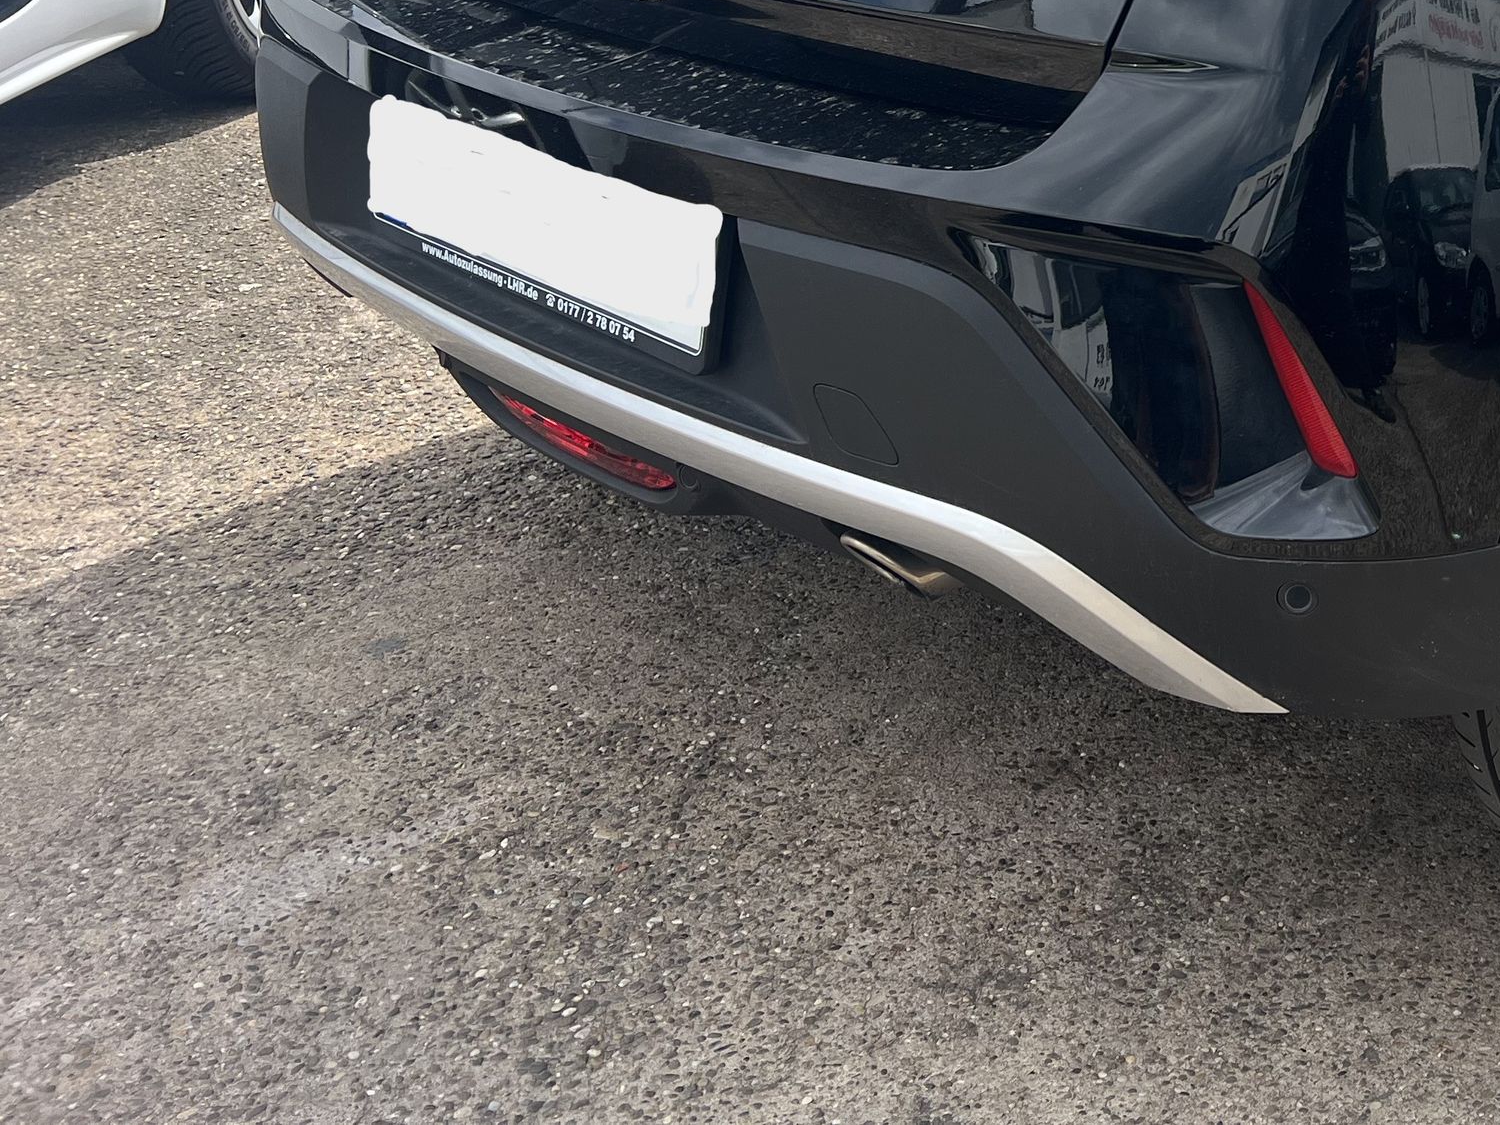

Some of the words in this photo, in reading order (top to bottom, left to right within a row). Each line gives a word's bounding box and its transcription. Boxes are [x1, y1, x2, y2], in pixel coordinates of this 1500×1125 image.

[557, 298, 580, 318] 0177
[586, 311, 594, 325] 2
[595, 314, 608, 331] 78
[608, 320, 621, 336] 07
[622, 326, 635, 343] 54
